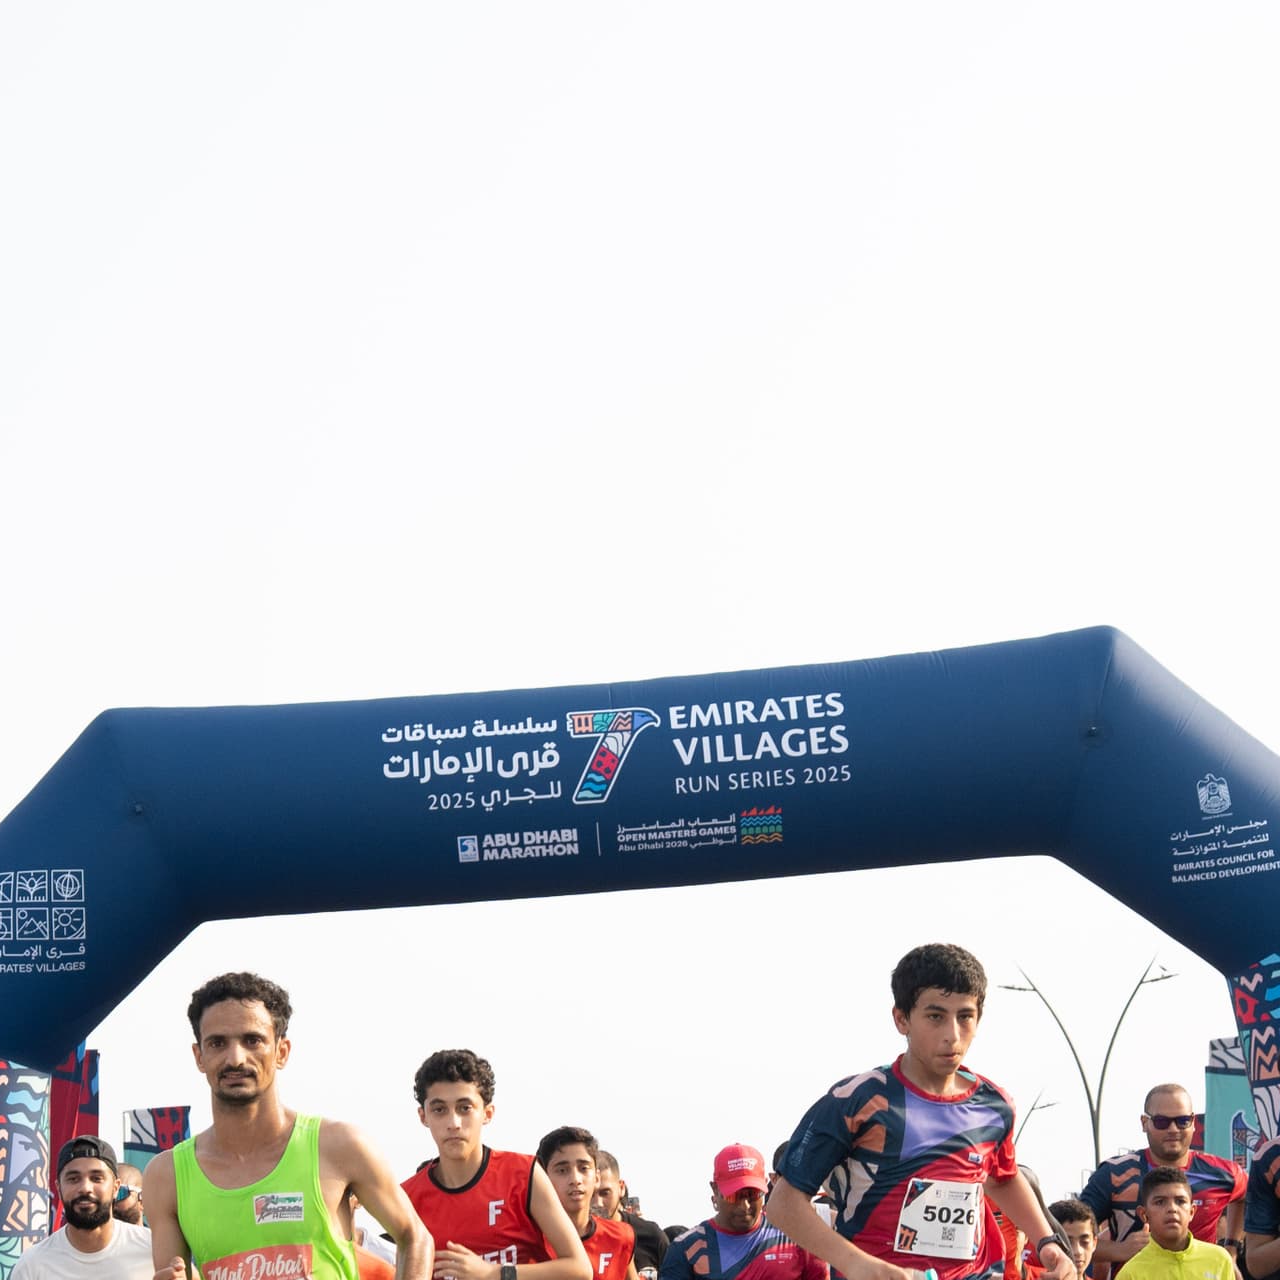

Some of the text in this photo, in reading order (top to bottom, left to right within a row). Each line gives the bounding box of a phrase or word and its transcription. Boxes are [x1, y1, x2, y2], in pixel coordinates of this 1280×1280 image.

[669, 692, 845, 729] EMIRATES
[381, 717, 558, 745] سلسلة سباقات
[672, 725, 849, 766] VILLAGES
[383, 741, 560, 784] قرى الإمارات
[675, 765, 851, 794] RUN SERIES 2025
[427, 780, 562, 812] للجري 2025
[482, 828, 578, 848] ABU DHABI
[617, 825, 737, 842] OPEN MASTERS GAMES
[1170, 819, 1267, 841] مجلس الإمارات
[483, 843, 579, 861] MARATHON
[618, 844, 636, 852] Abu
[638, 841, 664, 852] Dhabi
[1172, 833, 1269, 856] للتنمية المتوازنة
[1173, 849, 1275, 872] EMIRATES COUNCIL FOR
[1172, 872, 1217, 884] BALANCED
[45, 943, 86, 959] قرى
[36, 961, 86, 973] VILLAGES
[489, 1200, 505, 1226] F
[923, 1205, 975, 1225] 5026
[599, 1253, 612, 1274] F
